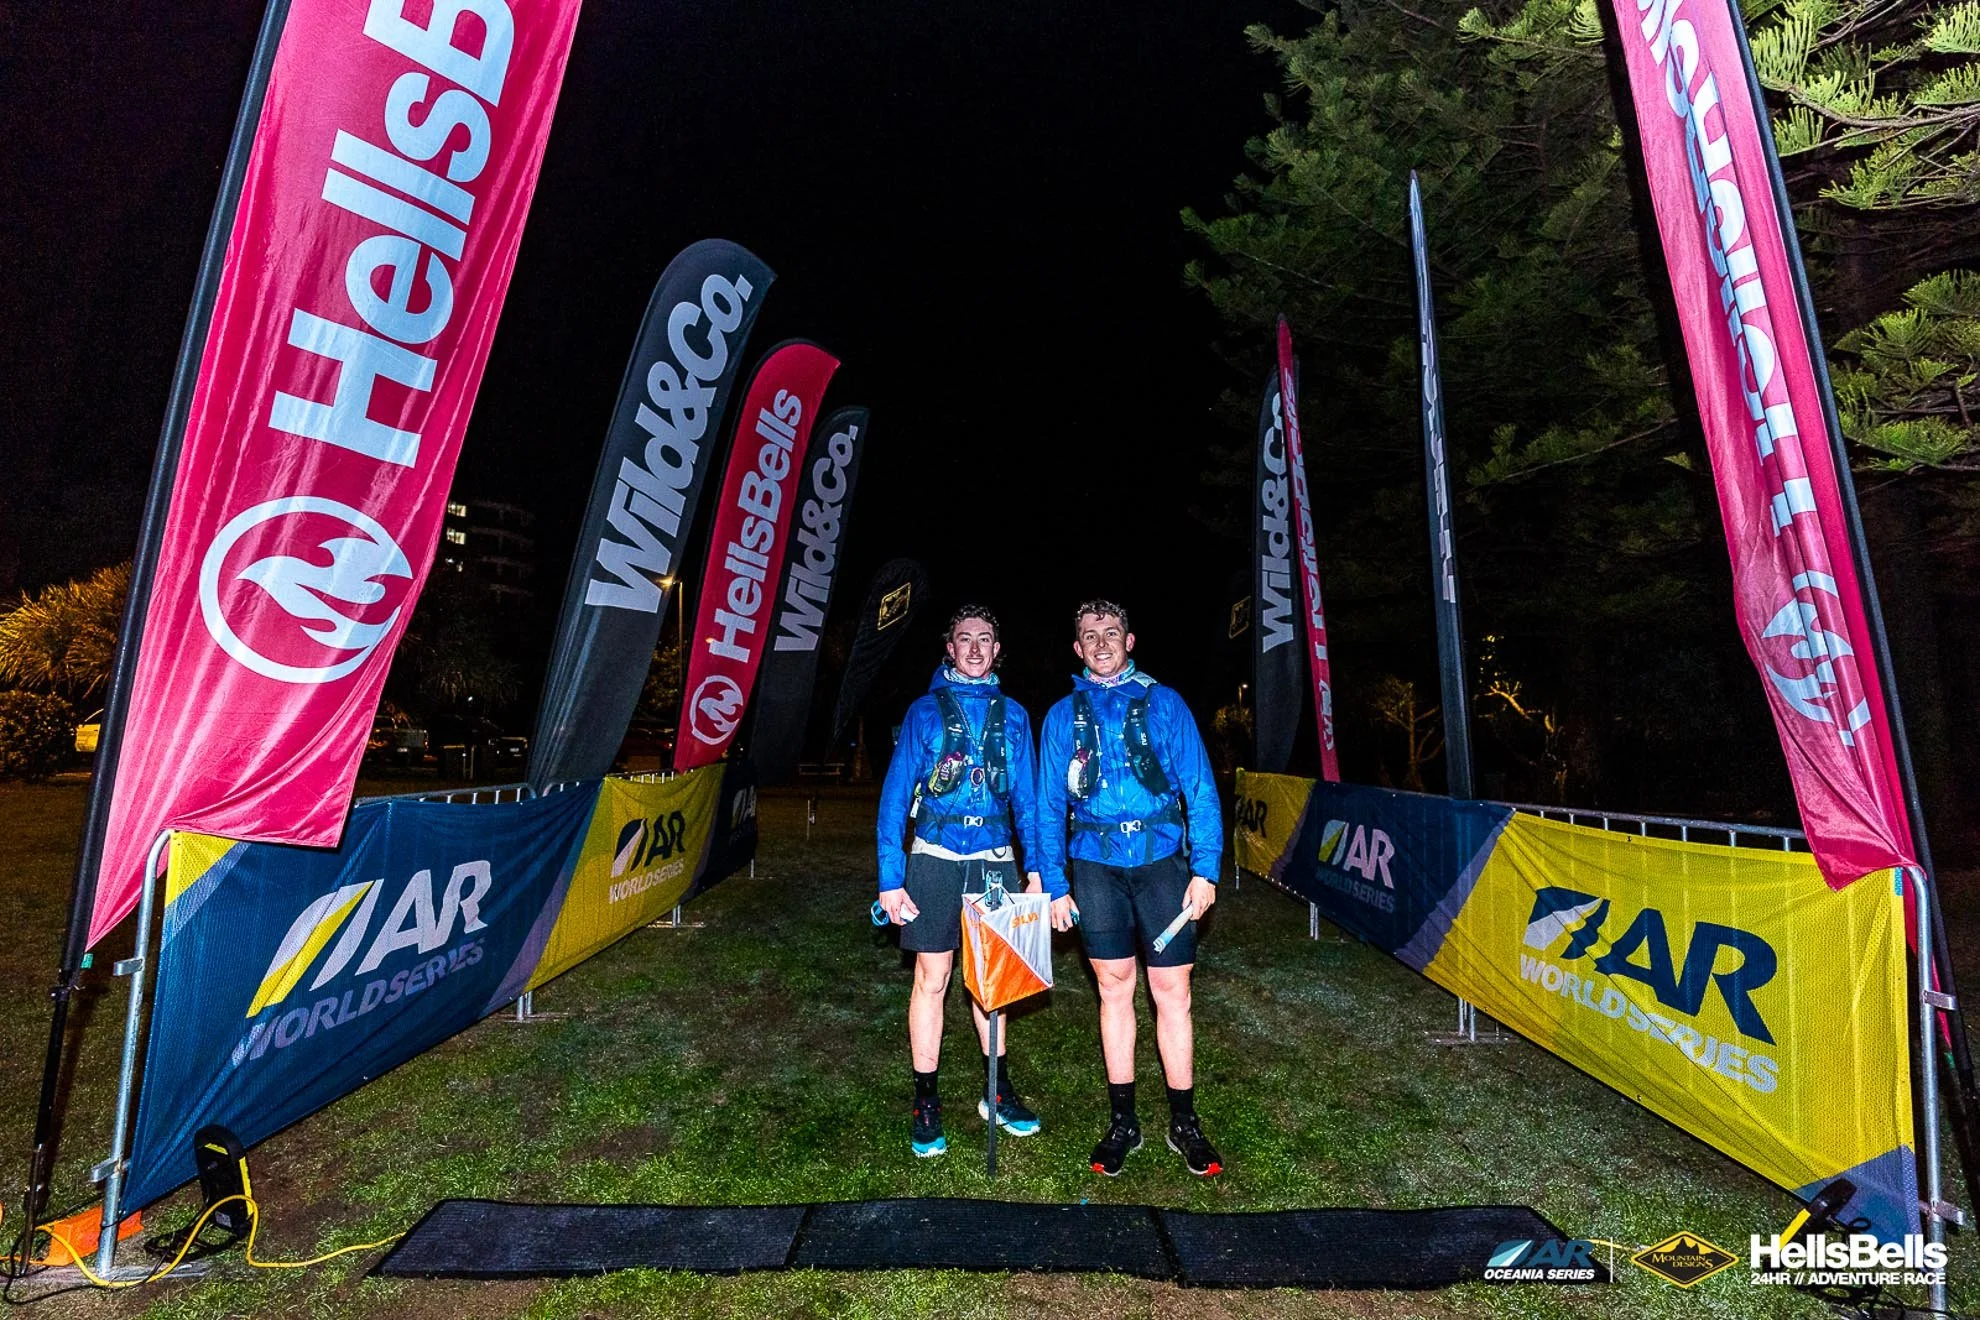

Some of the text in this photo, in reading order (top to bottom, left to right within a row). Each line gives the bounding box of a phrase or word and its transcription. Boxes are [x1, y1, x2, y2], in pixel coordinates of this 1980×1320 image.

[585, 274, 753, 614] Wild&Co.
[708, 389, 802, 663] HellsBells
[773, 424, 859, 652] Wild&Co.
[643, 811, 686, 869] AR
[1343, 825, 1395, 889] AR
[354, 860, 492, 976] AR
[1593, 907, 1778, 1047] AR
